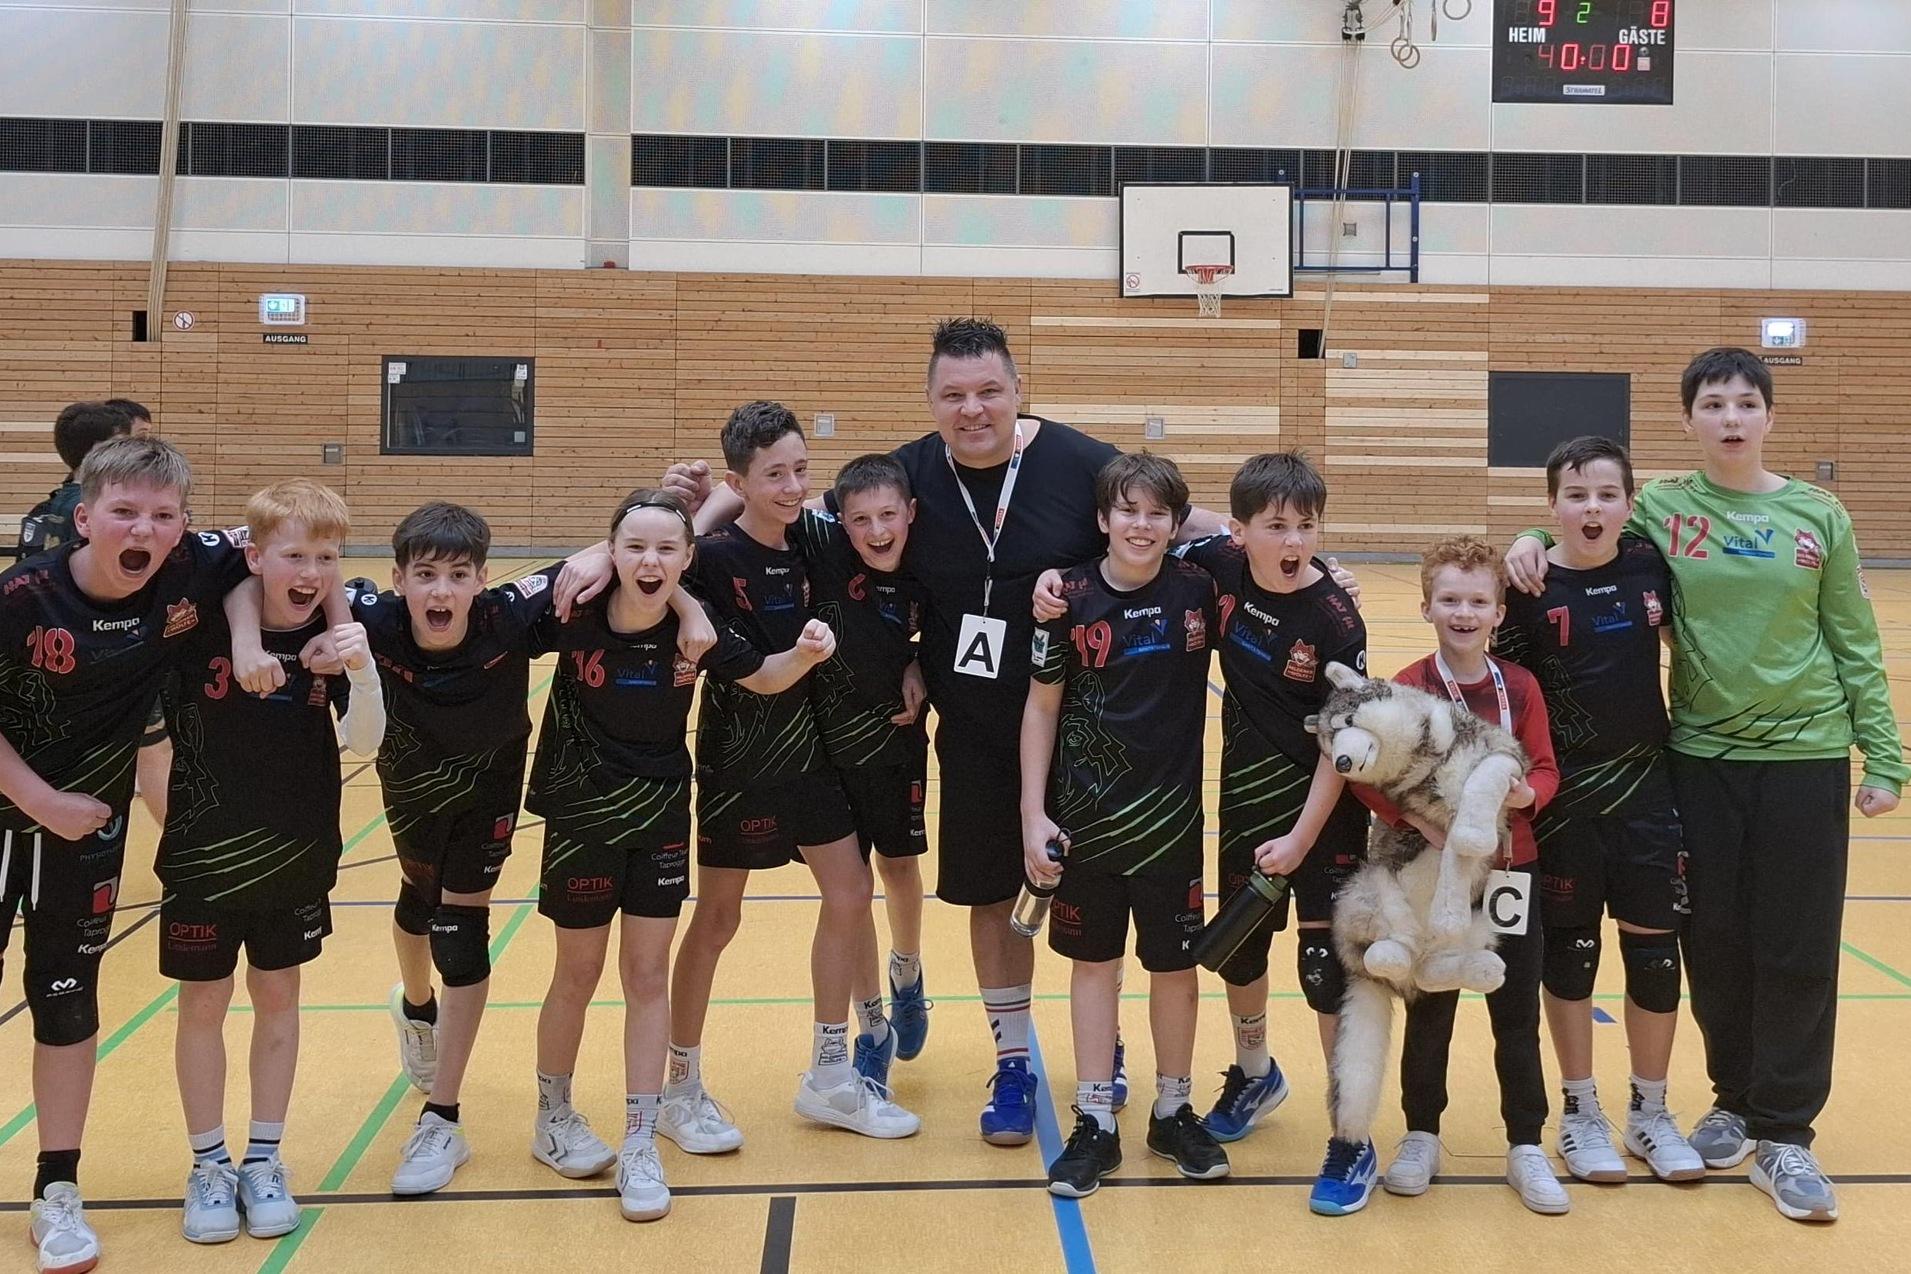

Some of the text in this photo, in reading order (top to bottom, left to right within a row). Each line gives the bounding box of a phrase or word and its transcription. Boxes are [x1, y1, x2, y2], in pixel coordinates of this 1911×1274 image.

[1537, 0, 1556, 26] 9
[1577, 2, 1591, 24] 2
[1651, 0, 1669, 27] 8
[1508, 27, 1546, 43] HEIM
[1618, 26, 1666, 45] GÄSTE
[265, 335, 306, 343] AUSGANG
[1726, 511, 1769, 525] Kempa
[1663, 512, 1711, 560] 12
[1723, 535, 1758, 550] Vital
[732, 577, 753, 612] 5
[1585, 584, 1618, 596] Kempa
[1124, 606, 1162, 619] Kempa
[1244, 601, 1280, 627] Kempa
[92, 616, 140, 632] Kempa
[1547, 605, 1570, 647] 7
[27, 625, 76, 674] 18
[1069, 619, 1112, 668] 19
[1121, 631, 1156, 647] Vital
[265, 650, 297, 662] empa
[958, 631, 994, 673] A
[204, 656, 231, 700] 3
[571, 650, 605, 688] 16
[567, 876, 613, 891] OPTIK
[1052, 899, 1081, 921] PTIK
[1488, 886, 1523, 927] C
[169, 921, 217, 938] OPTIK
[432, 924, 458, 934] Kempa
